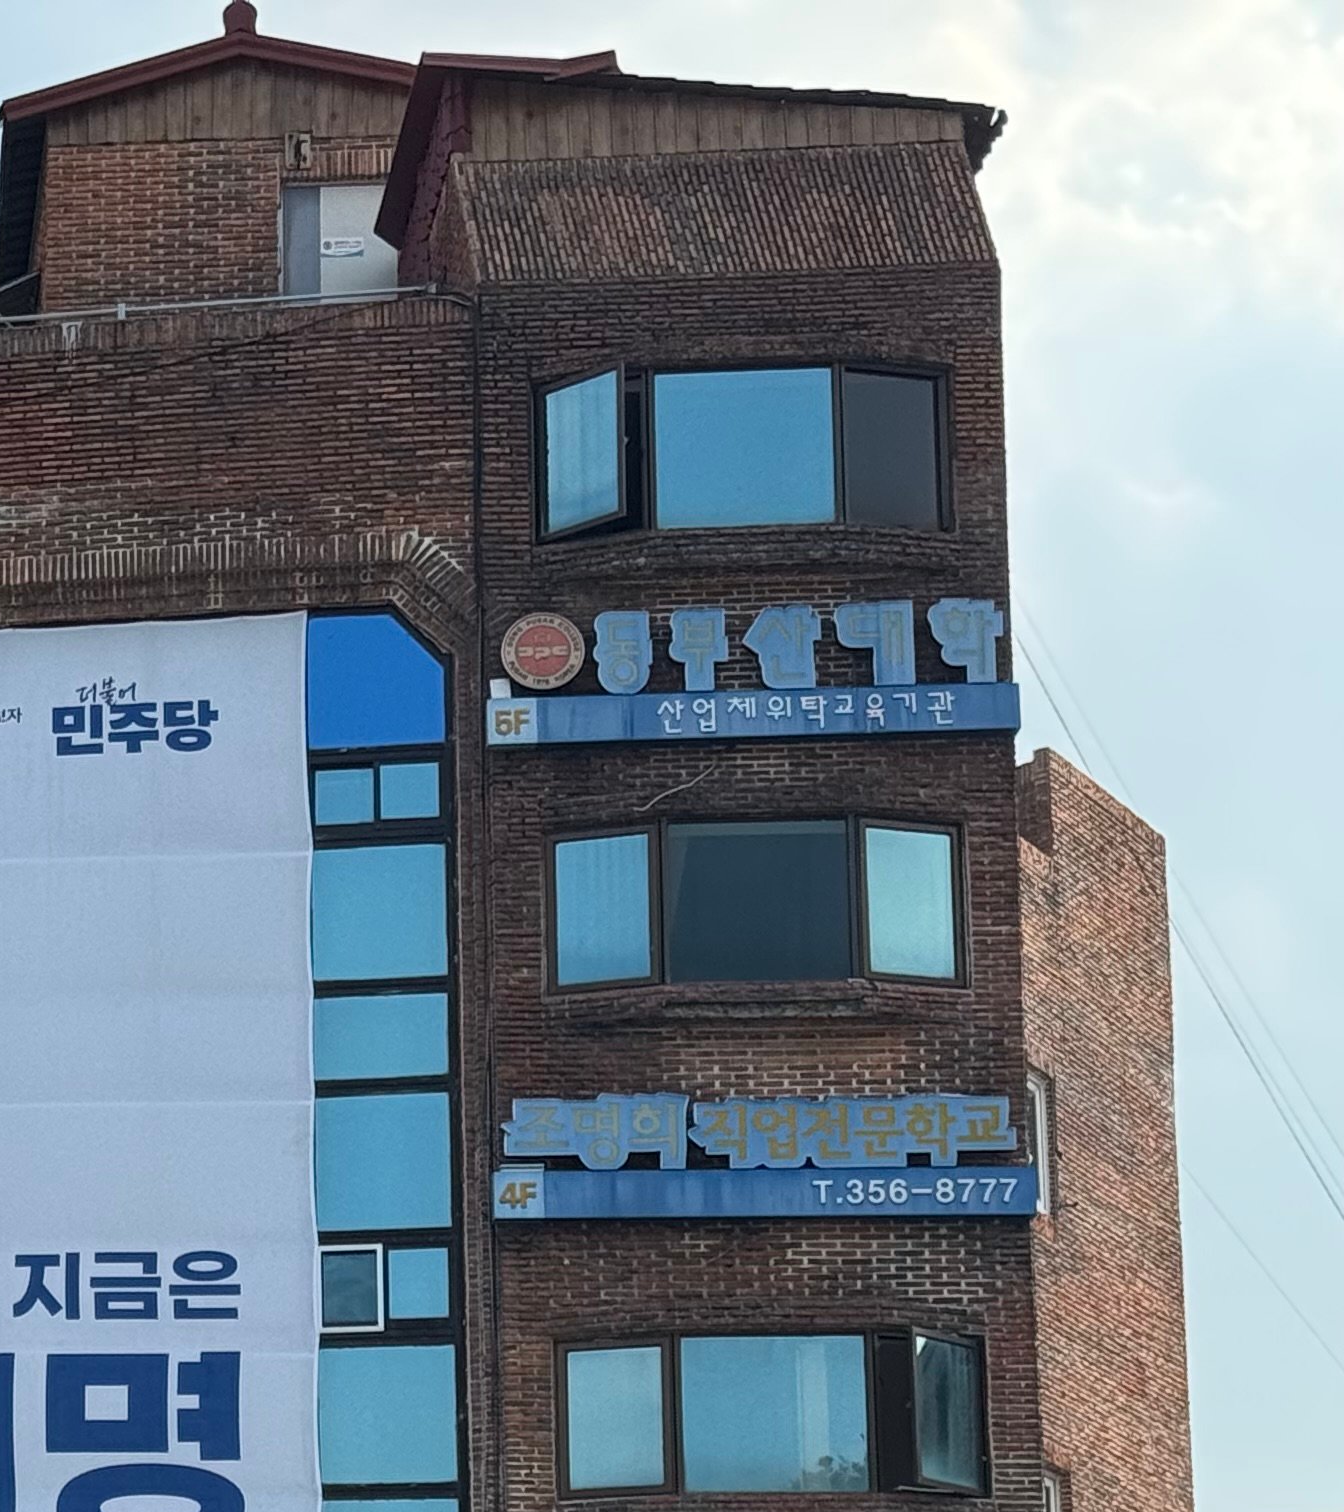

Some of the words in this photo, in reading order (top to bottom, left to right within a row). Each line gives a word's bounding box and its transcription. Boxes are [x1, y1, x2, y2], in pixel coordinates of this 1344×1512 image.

[596, 599, 1003, 693] 동부산대학
[76, 676, 138, 706] 더불어
[51, 700, 219, 756] 민주당
[494, 708, 531, 736] 5F
[698, 1100, 1010, 1165] 직업전문학교
[498, 1181, 539, 1209] 4F
[813, 1176, 1020, 1206] T.356-8777
[12, 1249, 243, 1321] 지금은
